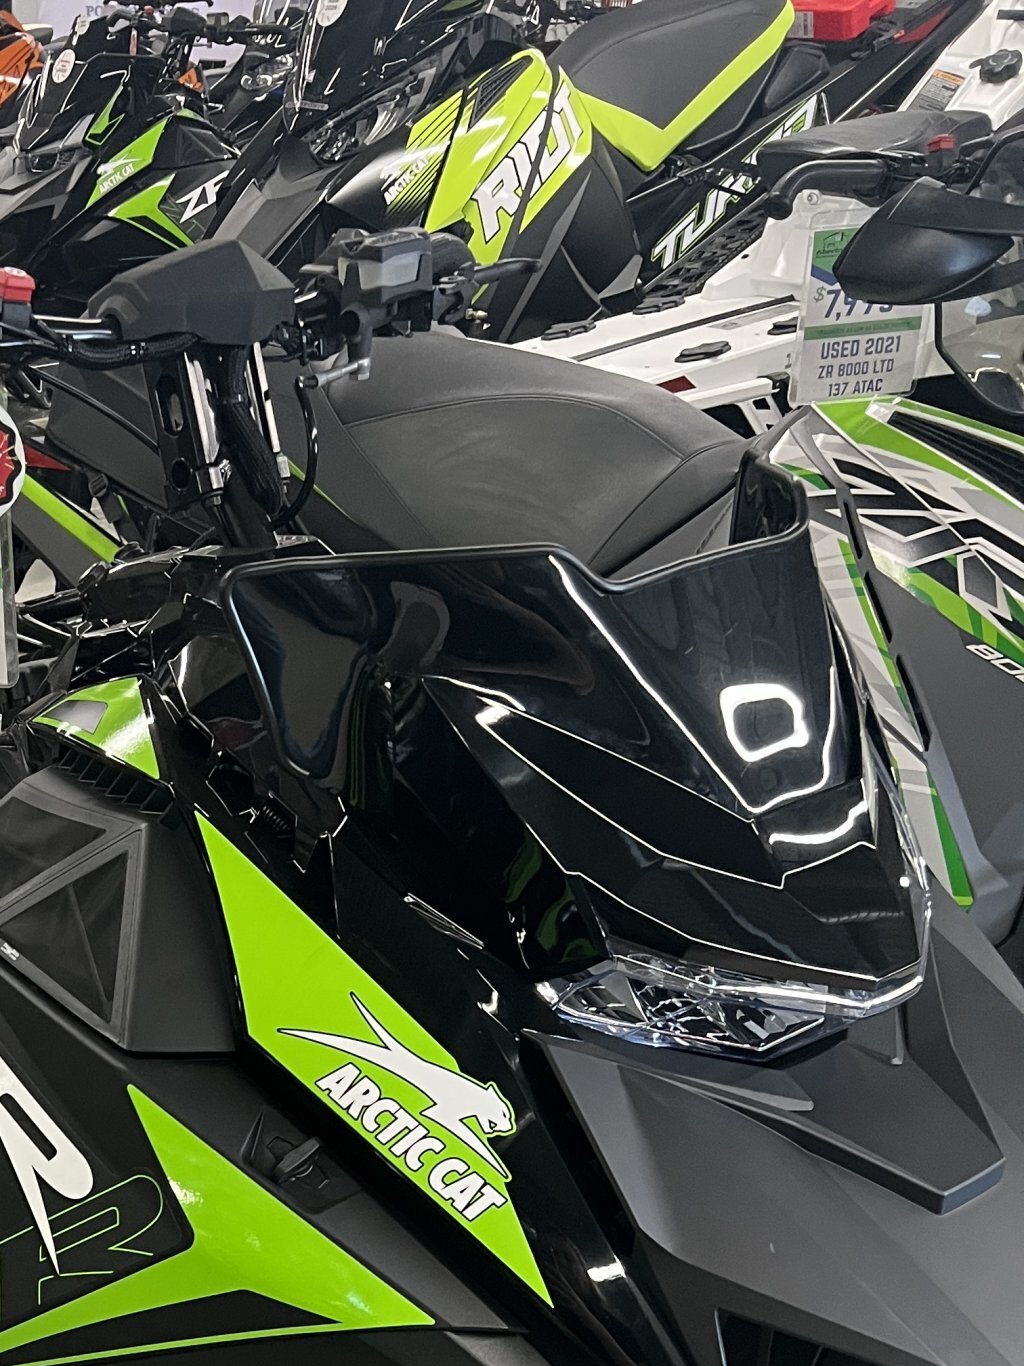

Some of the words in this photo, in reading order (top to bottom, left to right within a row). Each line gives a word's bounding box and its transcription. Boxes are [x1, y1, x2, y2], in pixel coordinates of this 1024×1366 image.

[471, 79, 583, 245] RIOT
[99, 172, 121, 195] ARCTIC
[119, 163, 136, 183] CAT
[383, 169, 415, 205] ARCTIC
[820, 338, 860, 361] USED
[865, 335, 902, 355] 2021
[818, 363, 833, 379] ZR
[837, 361, 869, 377] 8000
[872, 358, 894, 374] LTD
[828, 381, 849, 397] 137
[852, 379, 883, 395] ATAC
[315, 1062, 446, 1172] ARCTIC
[428, 1157, 508, 1222] CAT
